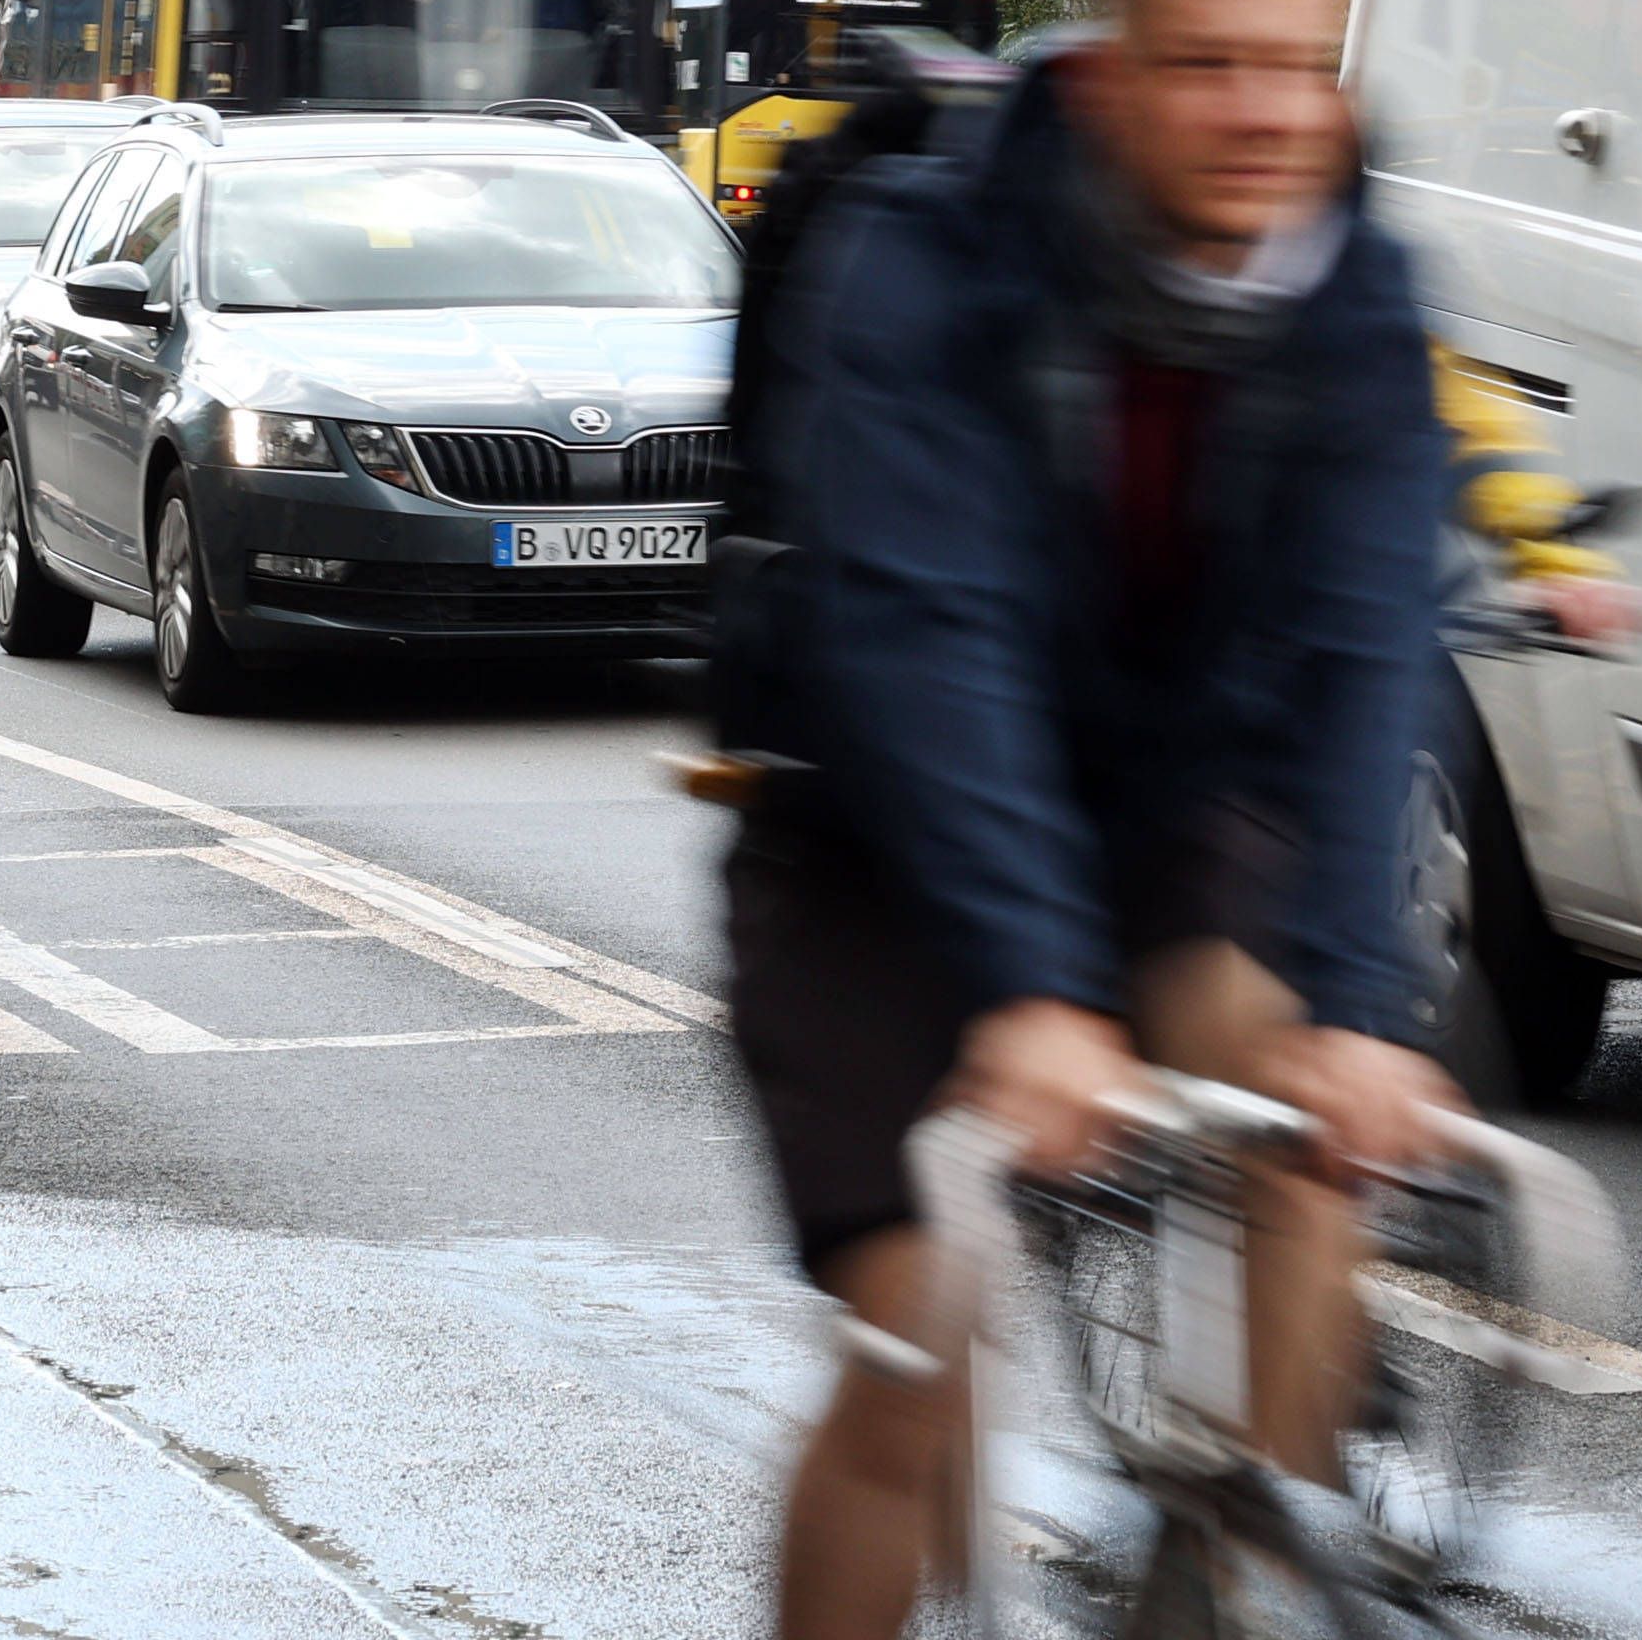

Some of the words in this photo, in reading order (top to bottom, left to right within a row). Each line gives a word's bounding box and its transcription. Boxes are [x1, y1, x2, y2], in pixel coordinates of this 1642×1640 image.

[517, 527, 538, 561] B
[564, 526, 608, 560] VQ
[618, 525, 704, 560] 9027
